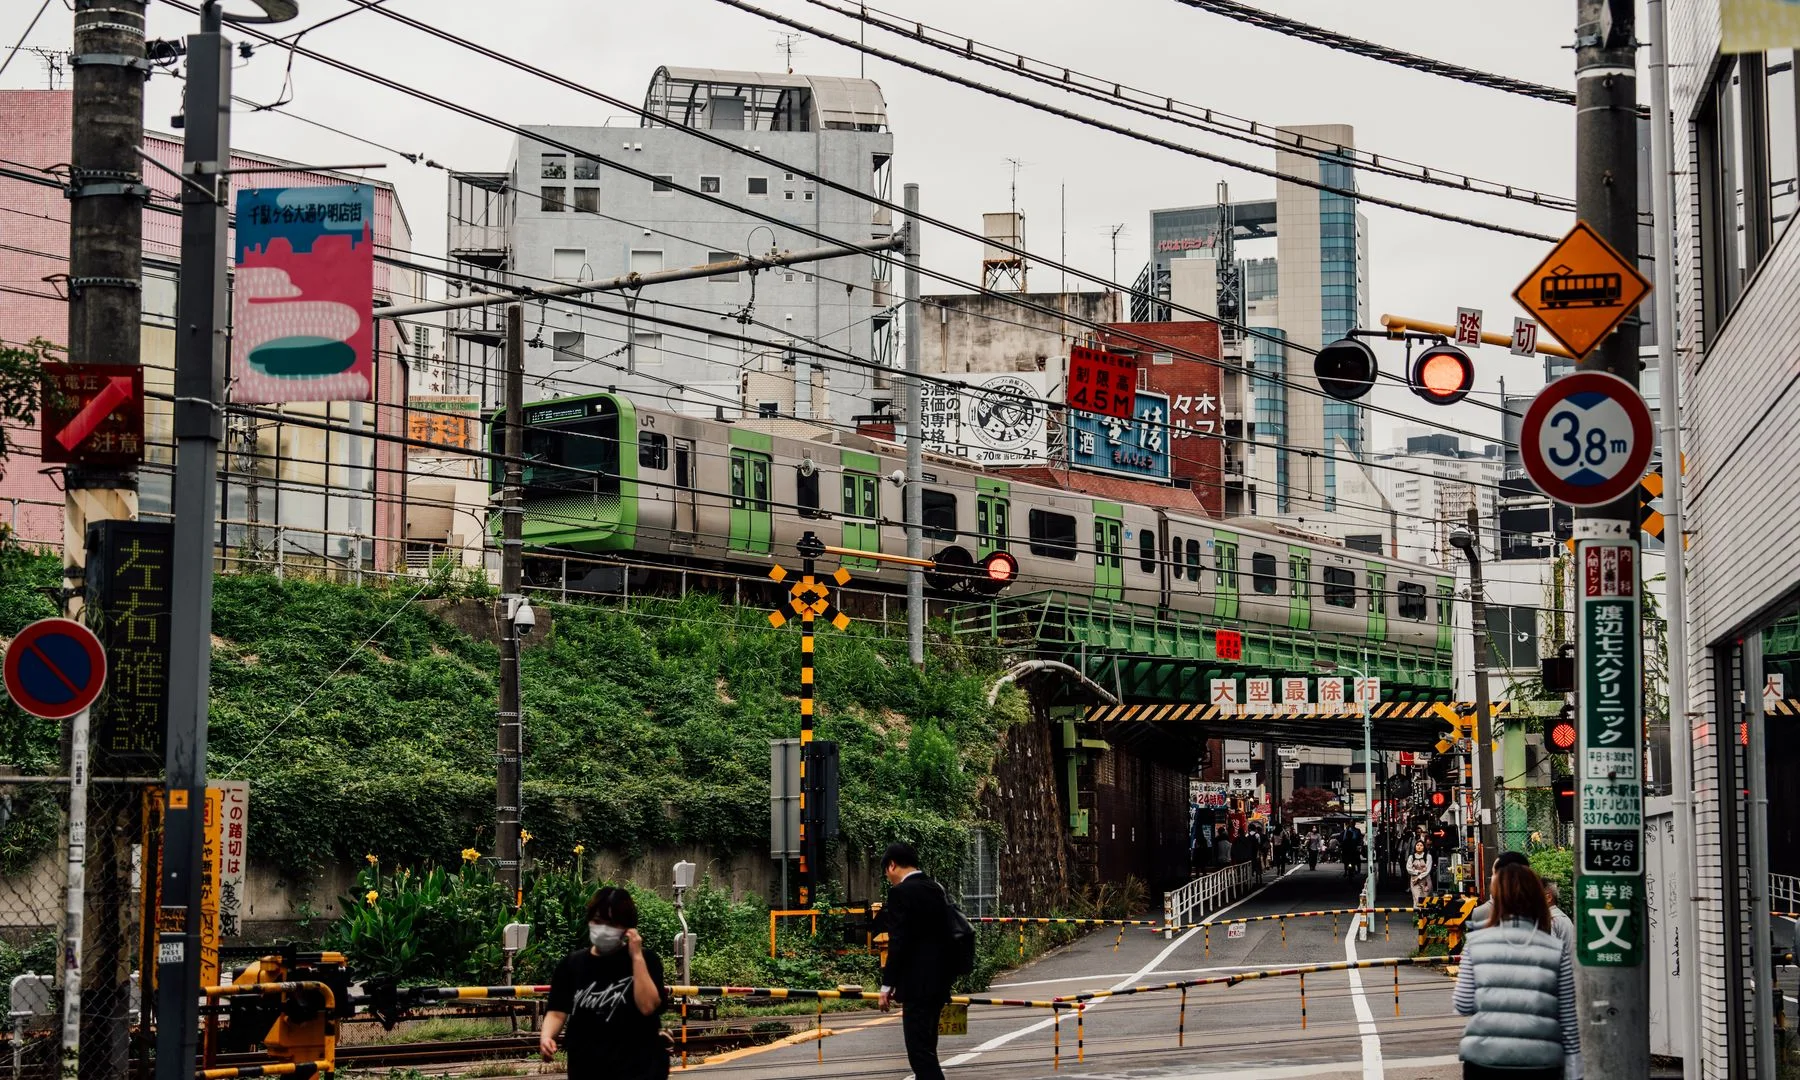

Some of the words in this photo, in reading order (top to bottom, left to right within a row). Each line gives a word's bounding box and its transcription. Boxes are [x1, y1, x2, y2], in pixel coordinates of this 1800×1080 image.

[641, 415, 655, 428] JR
[1549, 411, 1627, 467] 3.8m
[1588, 549, 1598, 594] 人間ドック
[113, 540, 164, 750] 左右確認
[1595, 605, 1625, 744] 渡辺七六クリニック
[228, 788, 243, 873] この踏切は
[1583, 812, 1640, 825] 3376-0076
[1593, 854, 1631, 867] 4-26
[1585, 885, 1633, 900] 通学路
